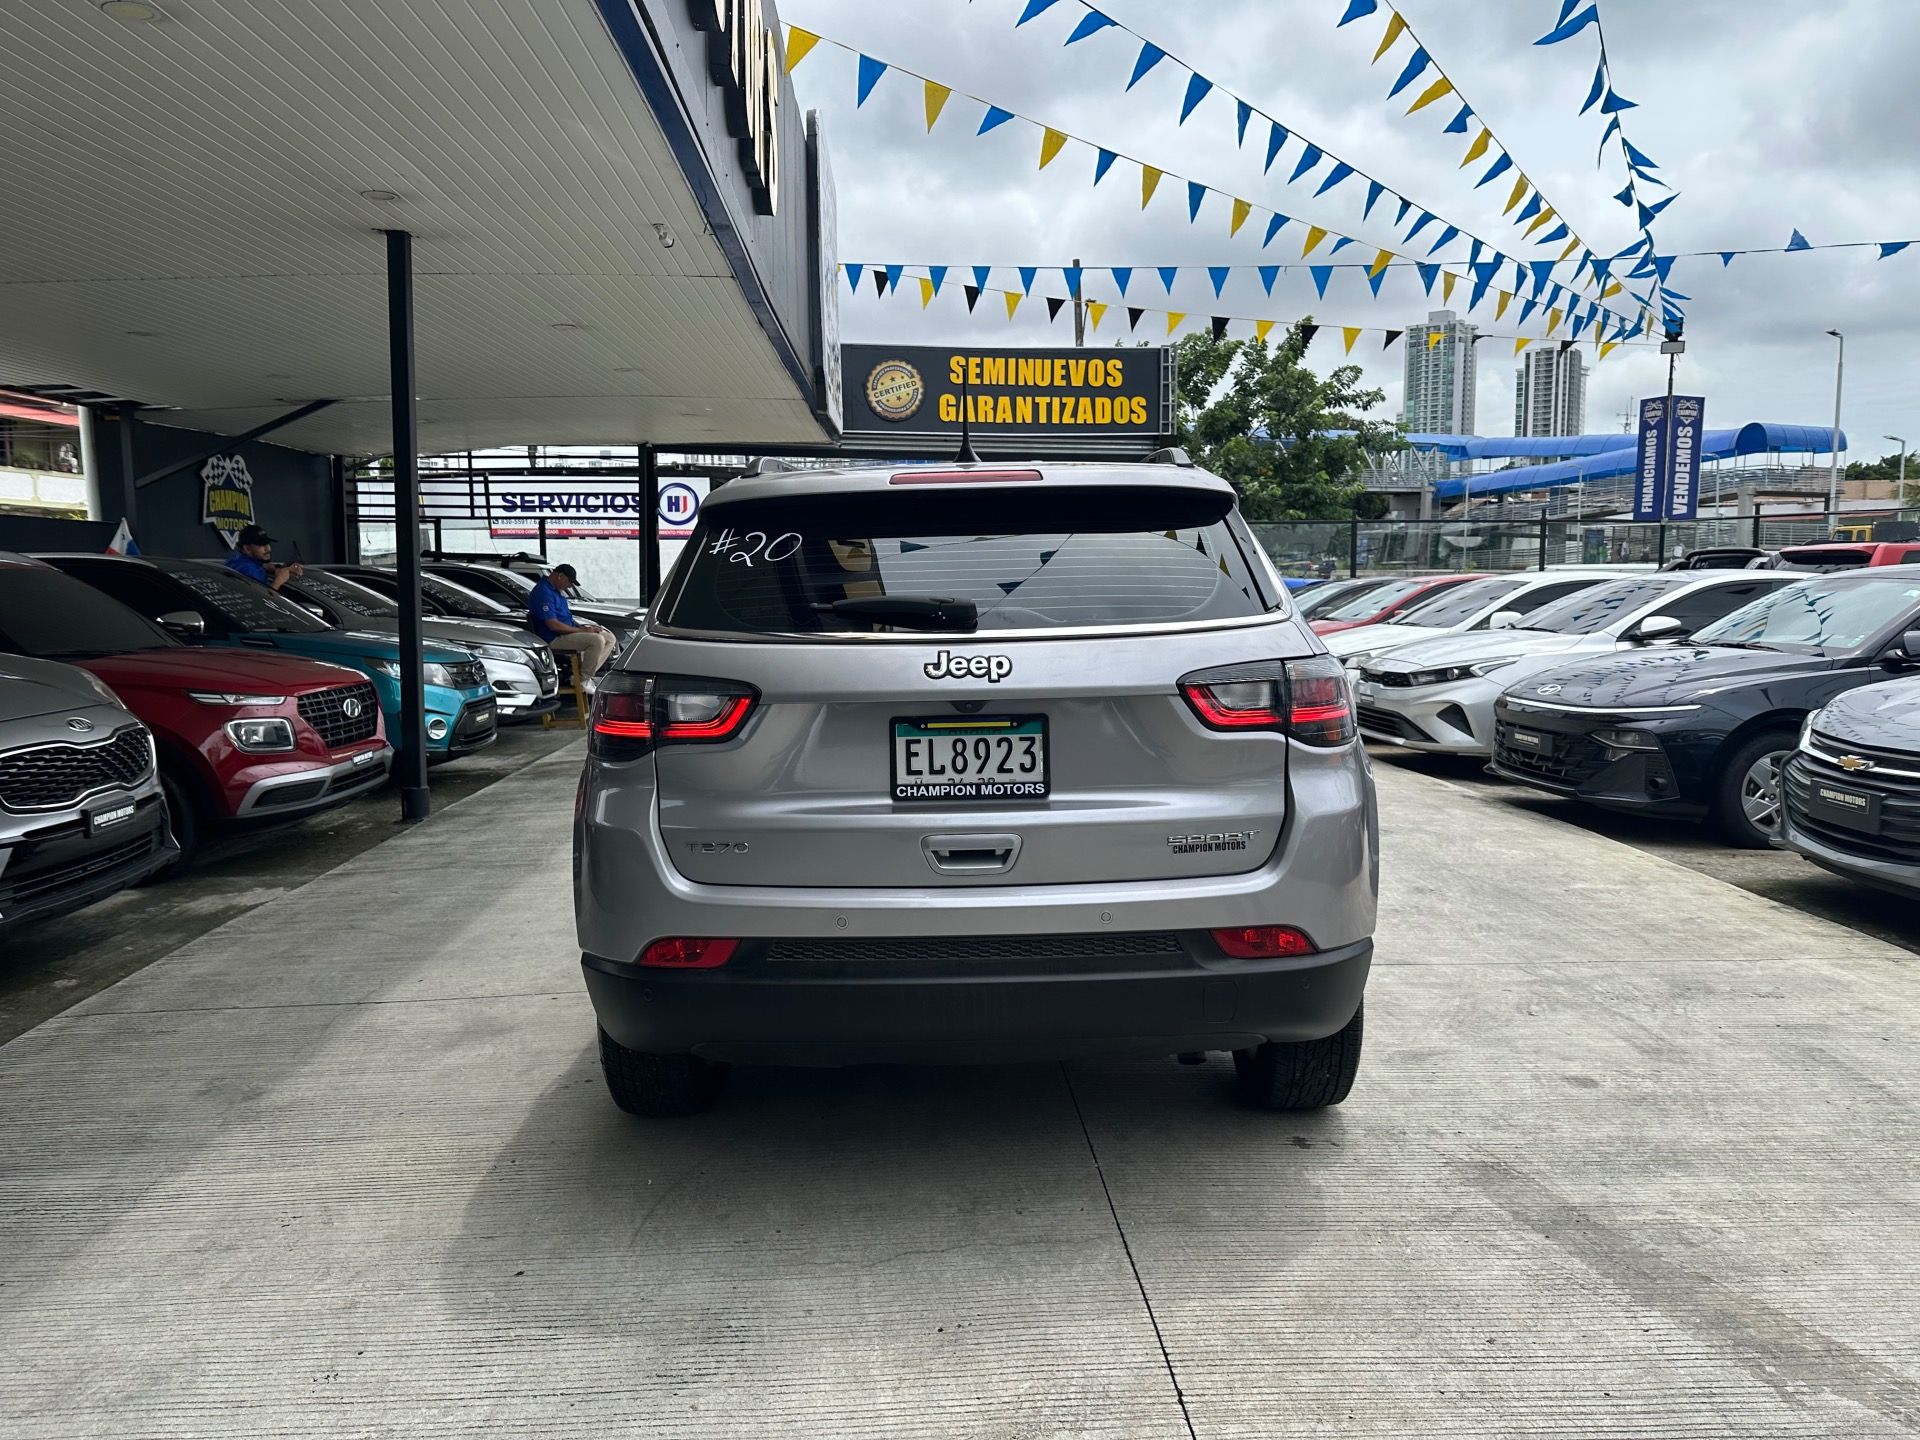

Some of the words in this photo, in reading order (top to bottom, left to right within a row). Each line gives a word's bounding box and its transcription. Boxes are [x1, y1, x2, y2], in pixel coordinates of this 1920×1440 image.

[950, 355, 1124, 387] SEMINUEVOS
[873, 380, 917, 399] CERTIFIED
[939, 393, 1147, 425] GARANTIZADOS
[1641, 429, 1658, 513] FINANCIAMOS
[1672, 426, 1693, 515] VENDEMOS
[209, 489, 250, 516] CHAMPION
[667, 495, 688, 514] HJ
[216, 517, 248, 531] MOTORS
[709, 527, 803, 567] #20
[924, 650, 1013, 683] Jeep
[905, 736, 1037, 776] EL8923
[896, 784, 976, 797] CHAMPION
[980, 783, 1045, 795] MOTORS
[1820, 788, 1845, 801] CHAMPION
[1844, 794, 1866, 806] MOTORS
[93, 810, 117, 825] CHAMPION
[1167, 829, 1260, 846] SPORT
[1173, 842, 1213, 854] CHAMPION
[1214, 840, 1246, 852] MOTORS
[687, 842, 749, 854] T270
